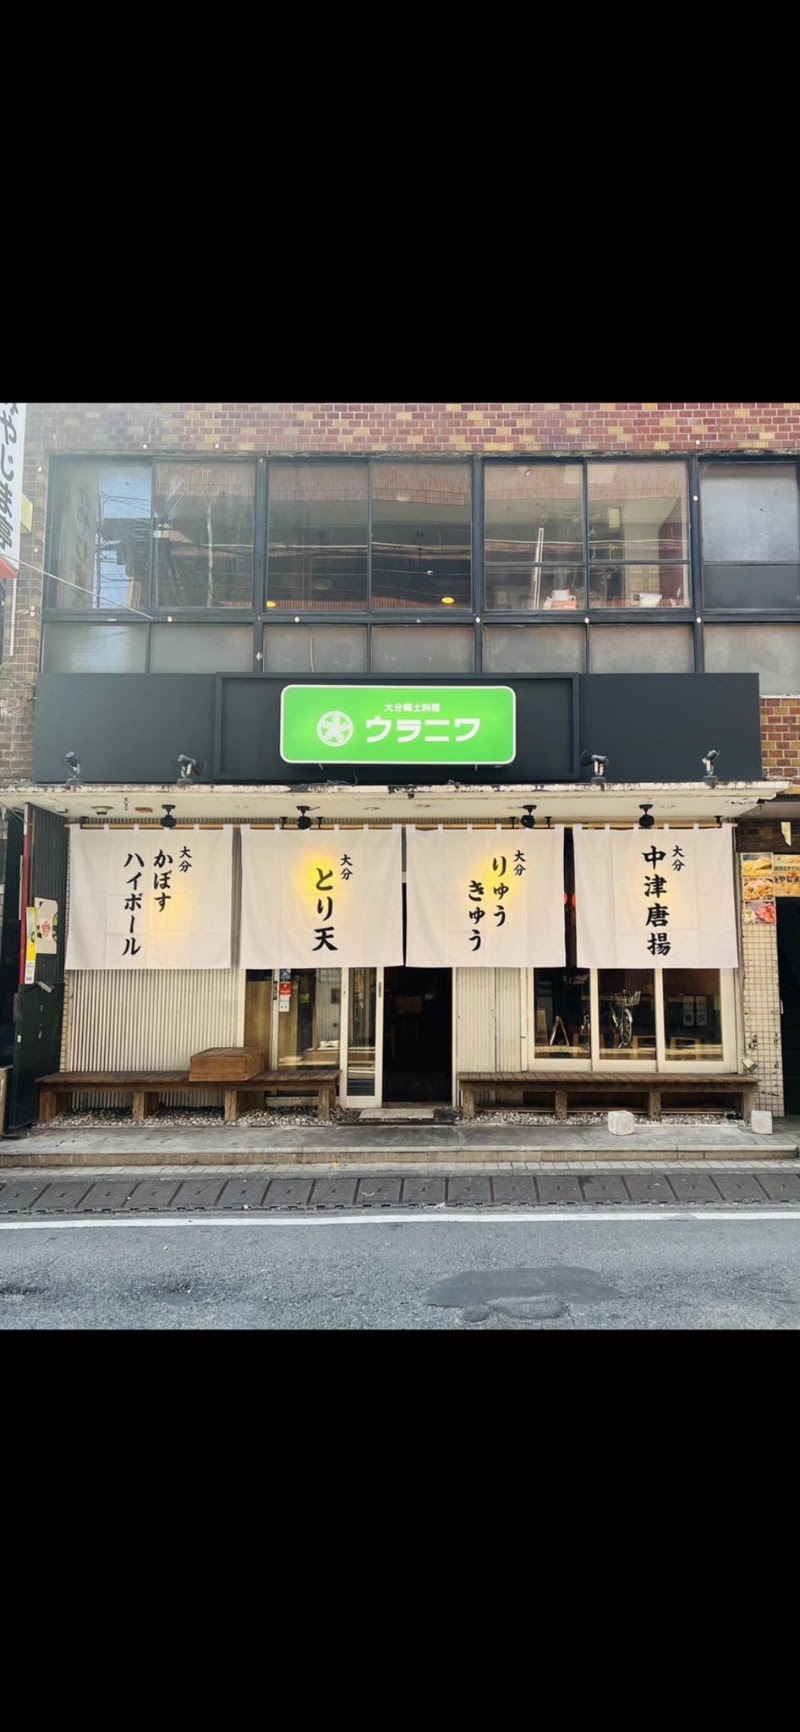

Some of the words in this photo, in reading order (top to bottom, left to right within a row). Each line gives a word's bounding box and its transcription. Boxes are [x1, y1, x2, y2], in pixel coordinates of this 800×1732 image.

[0, 403, 18, 550] やじま亭
[365, 716, 481, 743] ウラニワ
[384, 703, 441, 713] 大分郷土料理
[153, 849, 174, 912] かぼす
[179, 846, 192, 873] 大分
[340, 853, 353, 881] 大分
[513, 849, 526, 876] 大分
[671, 845, 685, 872] 大分
[122, 853, 145, 957] ハイボール
[312, 868, 338, 951] とり天
[468, 880, 486, 952] きゅう
[492, 856, 509, 927] りゅう
[642, 845, 671, 956] 中津唐揚
